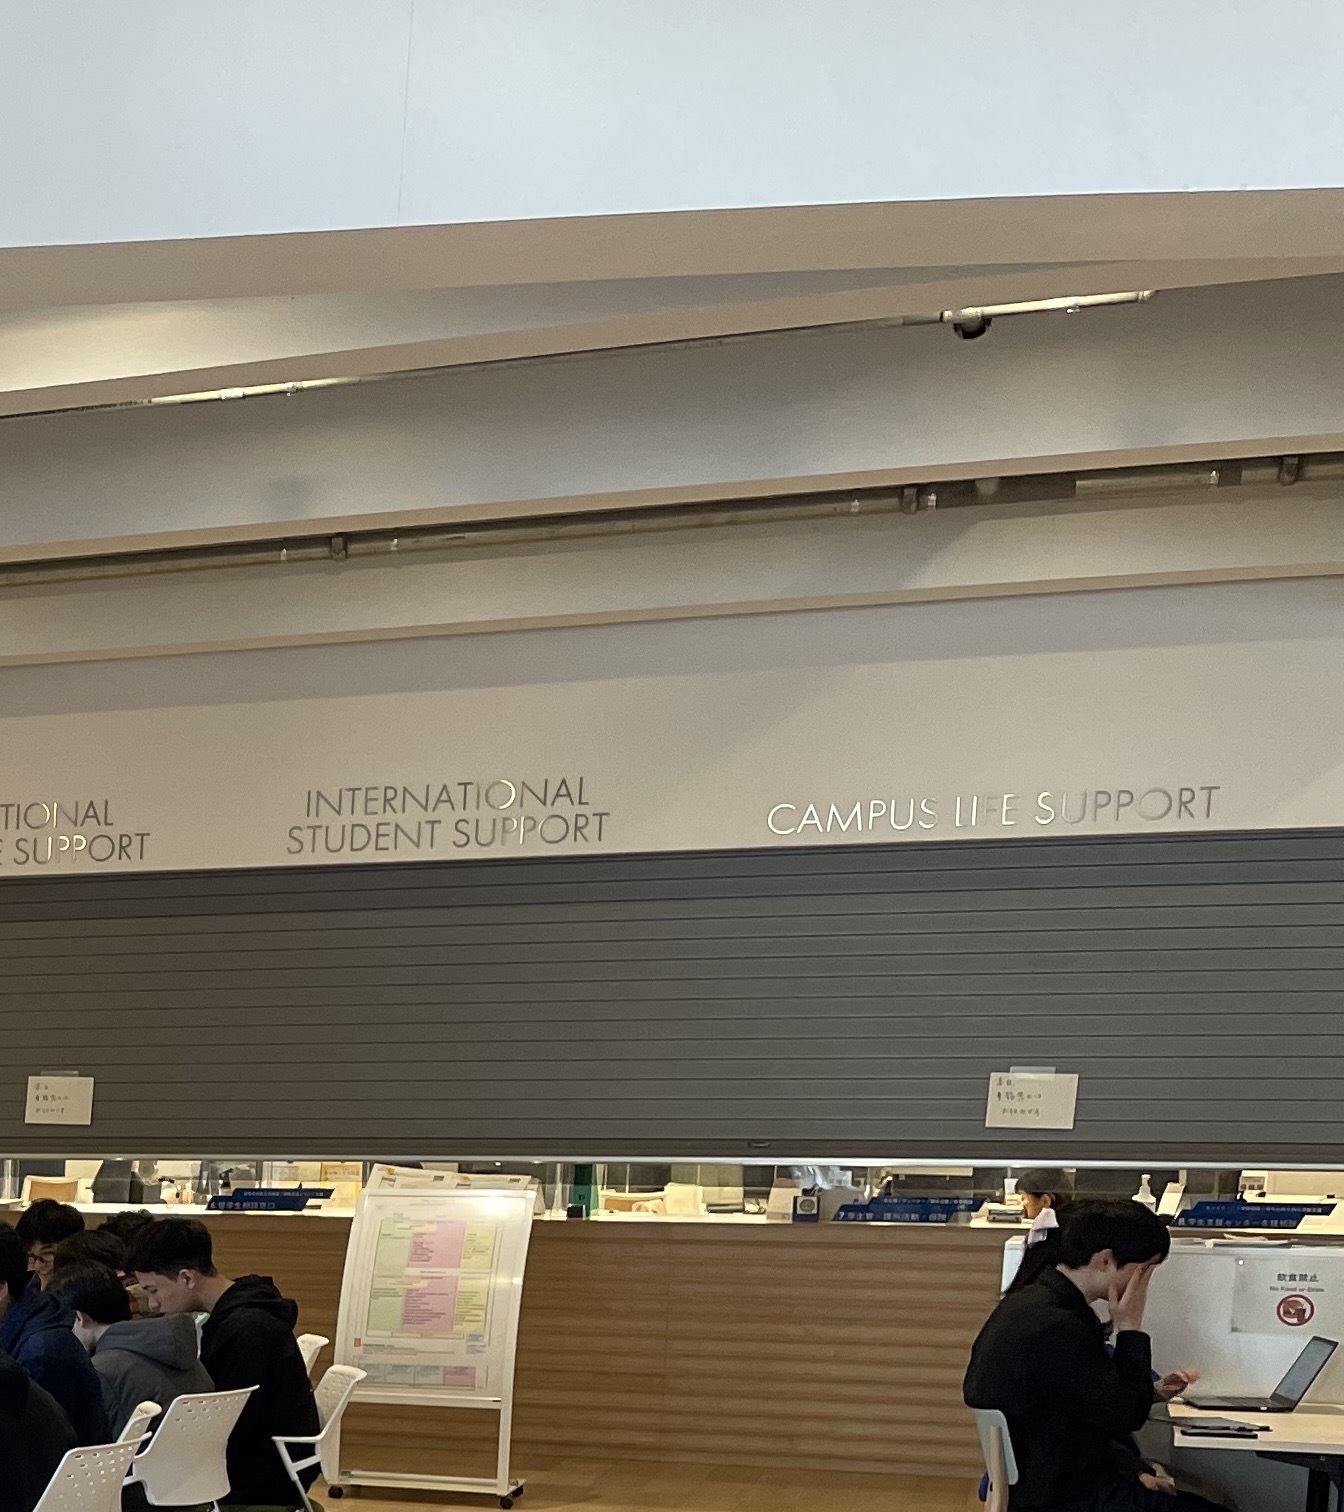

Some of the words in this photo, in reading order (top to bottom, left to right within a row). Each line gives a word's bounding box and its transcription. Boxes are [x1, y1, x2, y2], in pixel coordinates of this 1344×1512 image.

[307, 778, 591, 817] INTERNATIONAL
[767, 798, 938, 835] CAMPUS
[954, 794, 1019, 827] LIFE
[1035, 786, 1220, 825] SUPPORT
[13, 832, 151, 866] SUPPORT
[286, 817, 442, 854] STUDENT
[451, 812, 611, 847] SUPPORT
